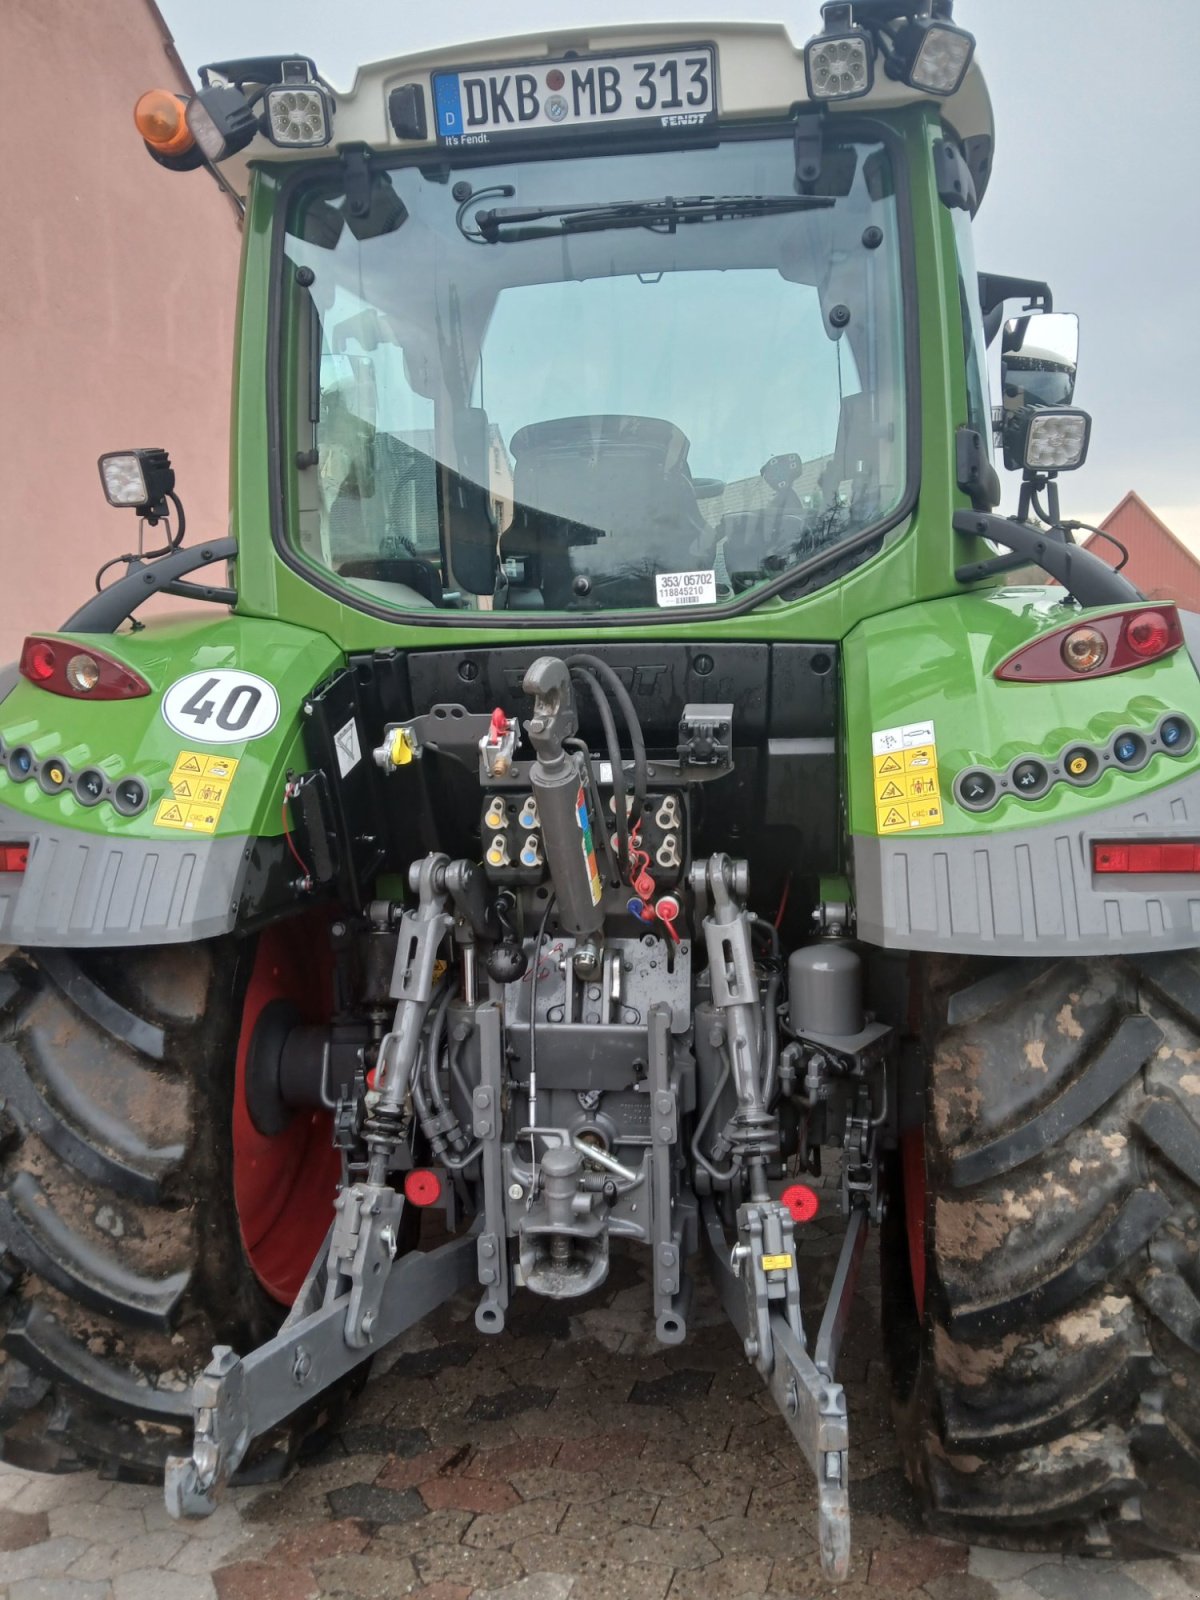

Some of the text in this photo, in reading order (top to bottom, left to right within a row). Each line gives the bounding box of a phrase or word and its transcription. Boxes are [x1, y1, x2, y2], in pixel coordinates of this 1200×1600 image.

[463, 57, 708, 126] DKB MB 313
[445, 112, 455, 125] D
[661, 113, 707, 127] FENDT
[180, 677, 262, 731] 40
